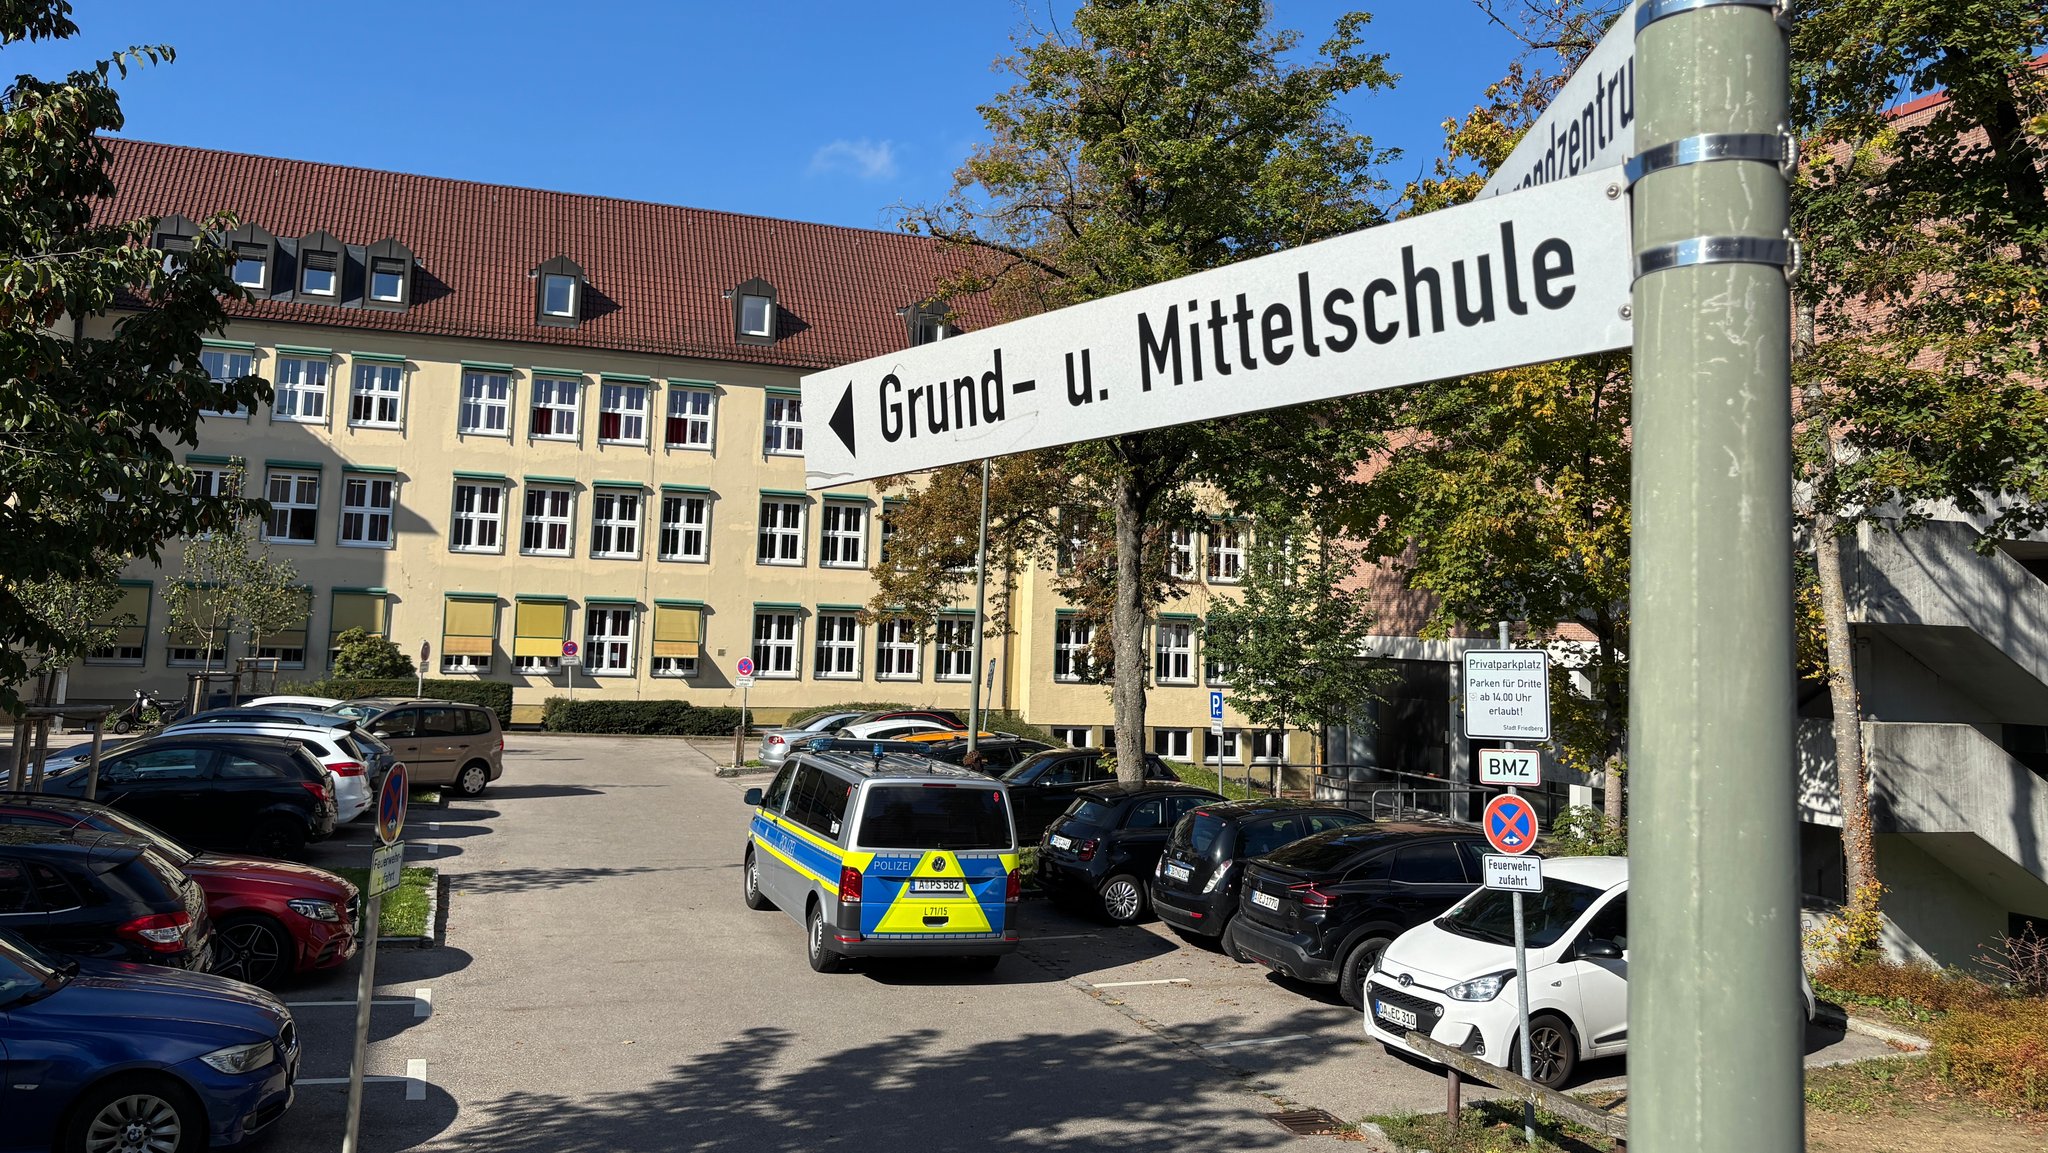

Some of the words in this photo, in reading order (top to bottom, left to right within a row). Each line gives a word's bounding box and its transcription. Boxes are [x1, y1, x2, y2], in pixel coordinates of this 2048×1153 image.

[879, 347, 1036, 443] Grund-
[1065, 348, 1109, 407] u.
[1138, 220, 1577, 392] Mittelschule
[1469, 659, 1542, 671] Privatparkplatz
[1470, 678, 1500, 688] Parken
[1502, 678, 1515, 688] für
[1517, 679, 1542, 688] Dritte
[1479, 692, 1490, 701] ab
[1492, 692, 1513, 702] 14.00
[1515, 693, 1532, 702] Uhr
[1212, 695, 1220, 716] P
[1488, 707, 1523, 716] erlaubt!
[1489, 759, 1529, 776] BMZ
[873, 860, 911, 871] POLIZEI
[1488, 859, 1536, 872] Feuerwehr-
[918, 880, 925, 889] A
[930, 880, 942, 890] PS
[943, 880, 960, 890] 582
[1498, 875, 1529, 887] zufahrt
[924, 907, 928, 916] L
[930, 907, 948, 916] 71/15
[1391, 1007, 1400, 1021] EC
[1401, 1011, 1416, 1026] 310
